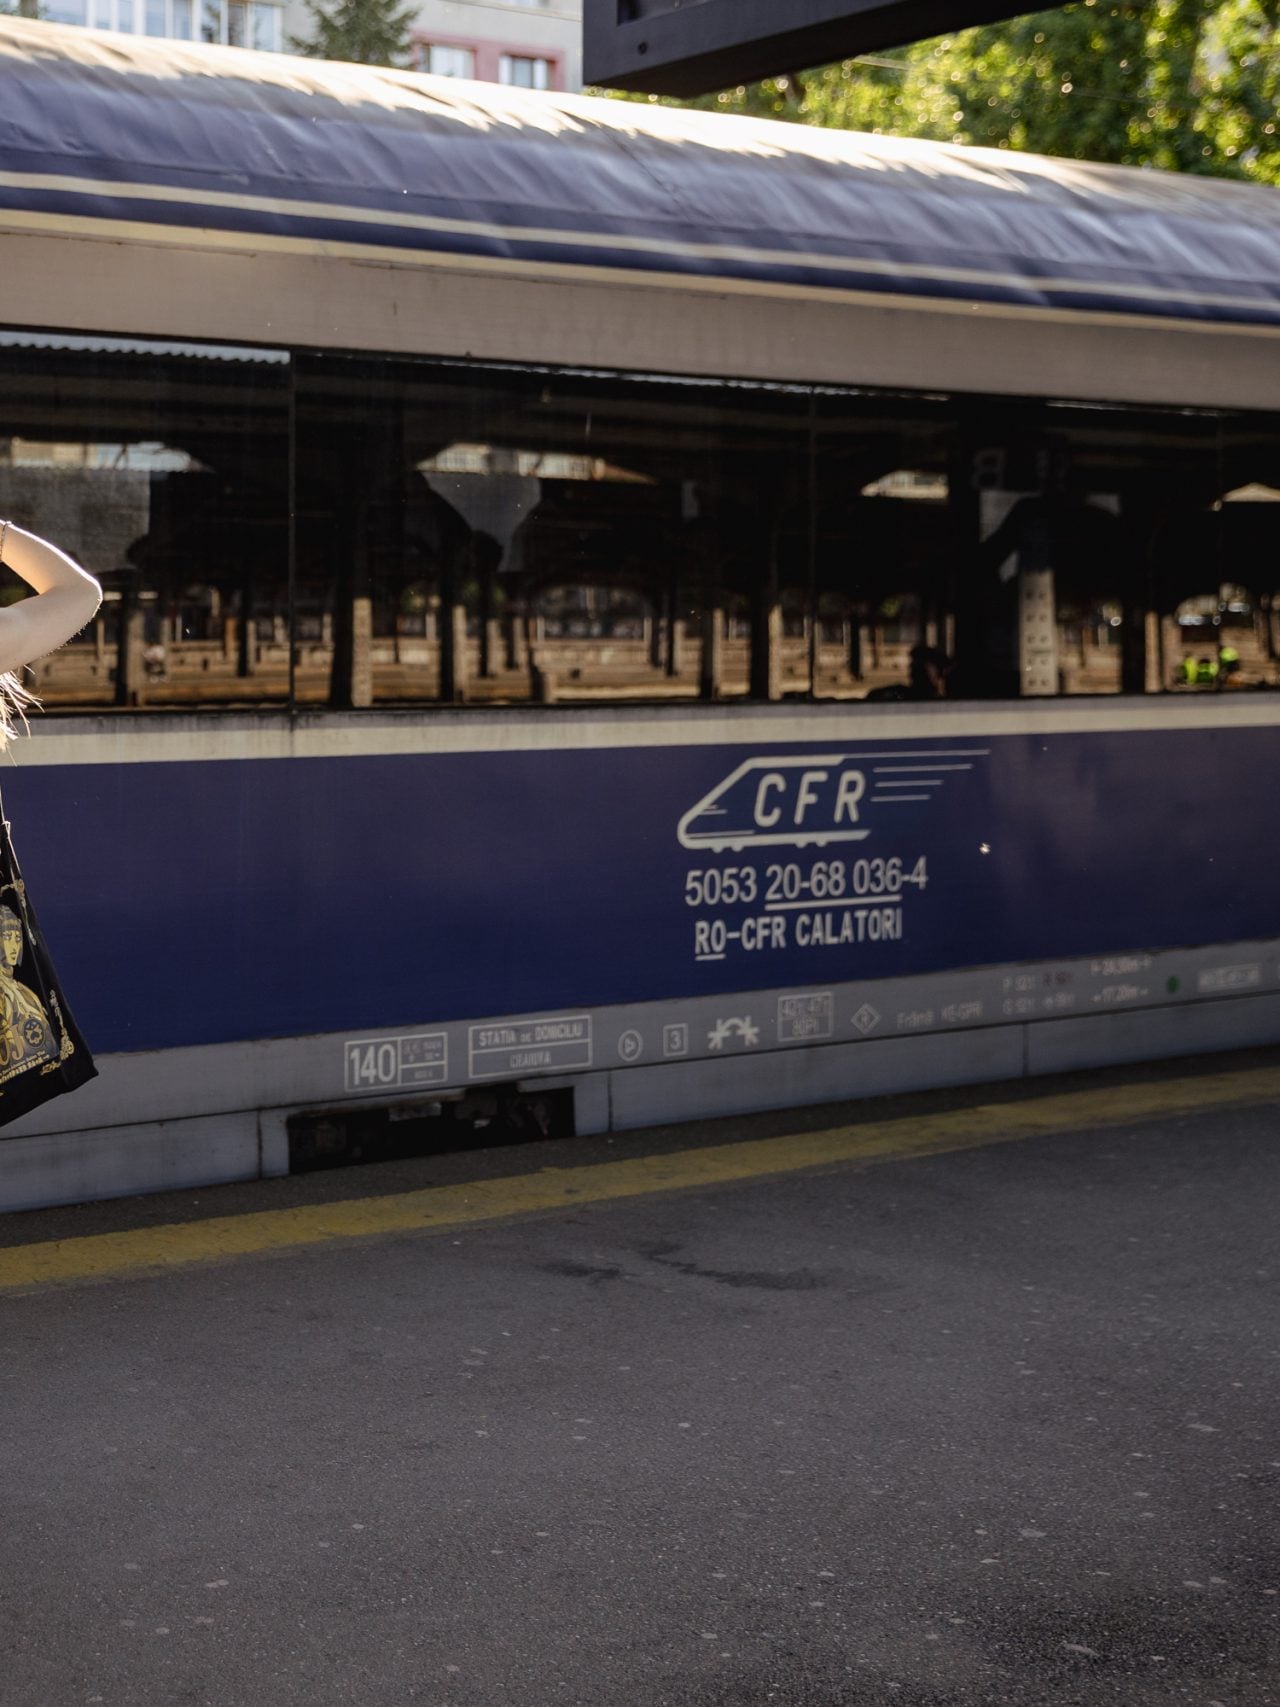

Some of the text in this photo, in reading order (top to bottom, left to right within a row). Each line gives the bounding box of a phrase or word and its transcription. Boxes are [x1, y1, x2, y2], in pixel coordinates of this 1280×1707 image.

[754, 769, 867, 828] CFR
[685, 856, 928, 907] 5053 20-68 036-4
[694, 908, 903, 955] RO-CFR CALATORI
[670, 1030, 682, 1050] 3
[350, 1043, 397, 1086] 140
